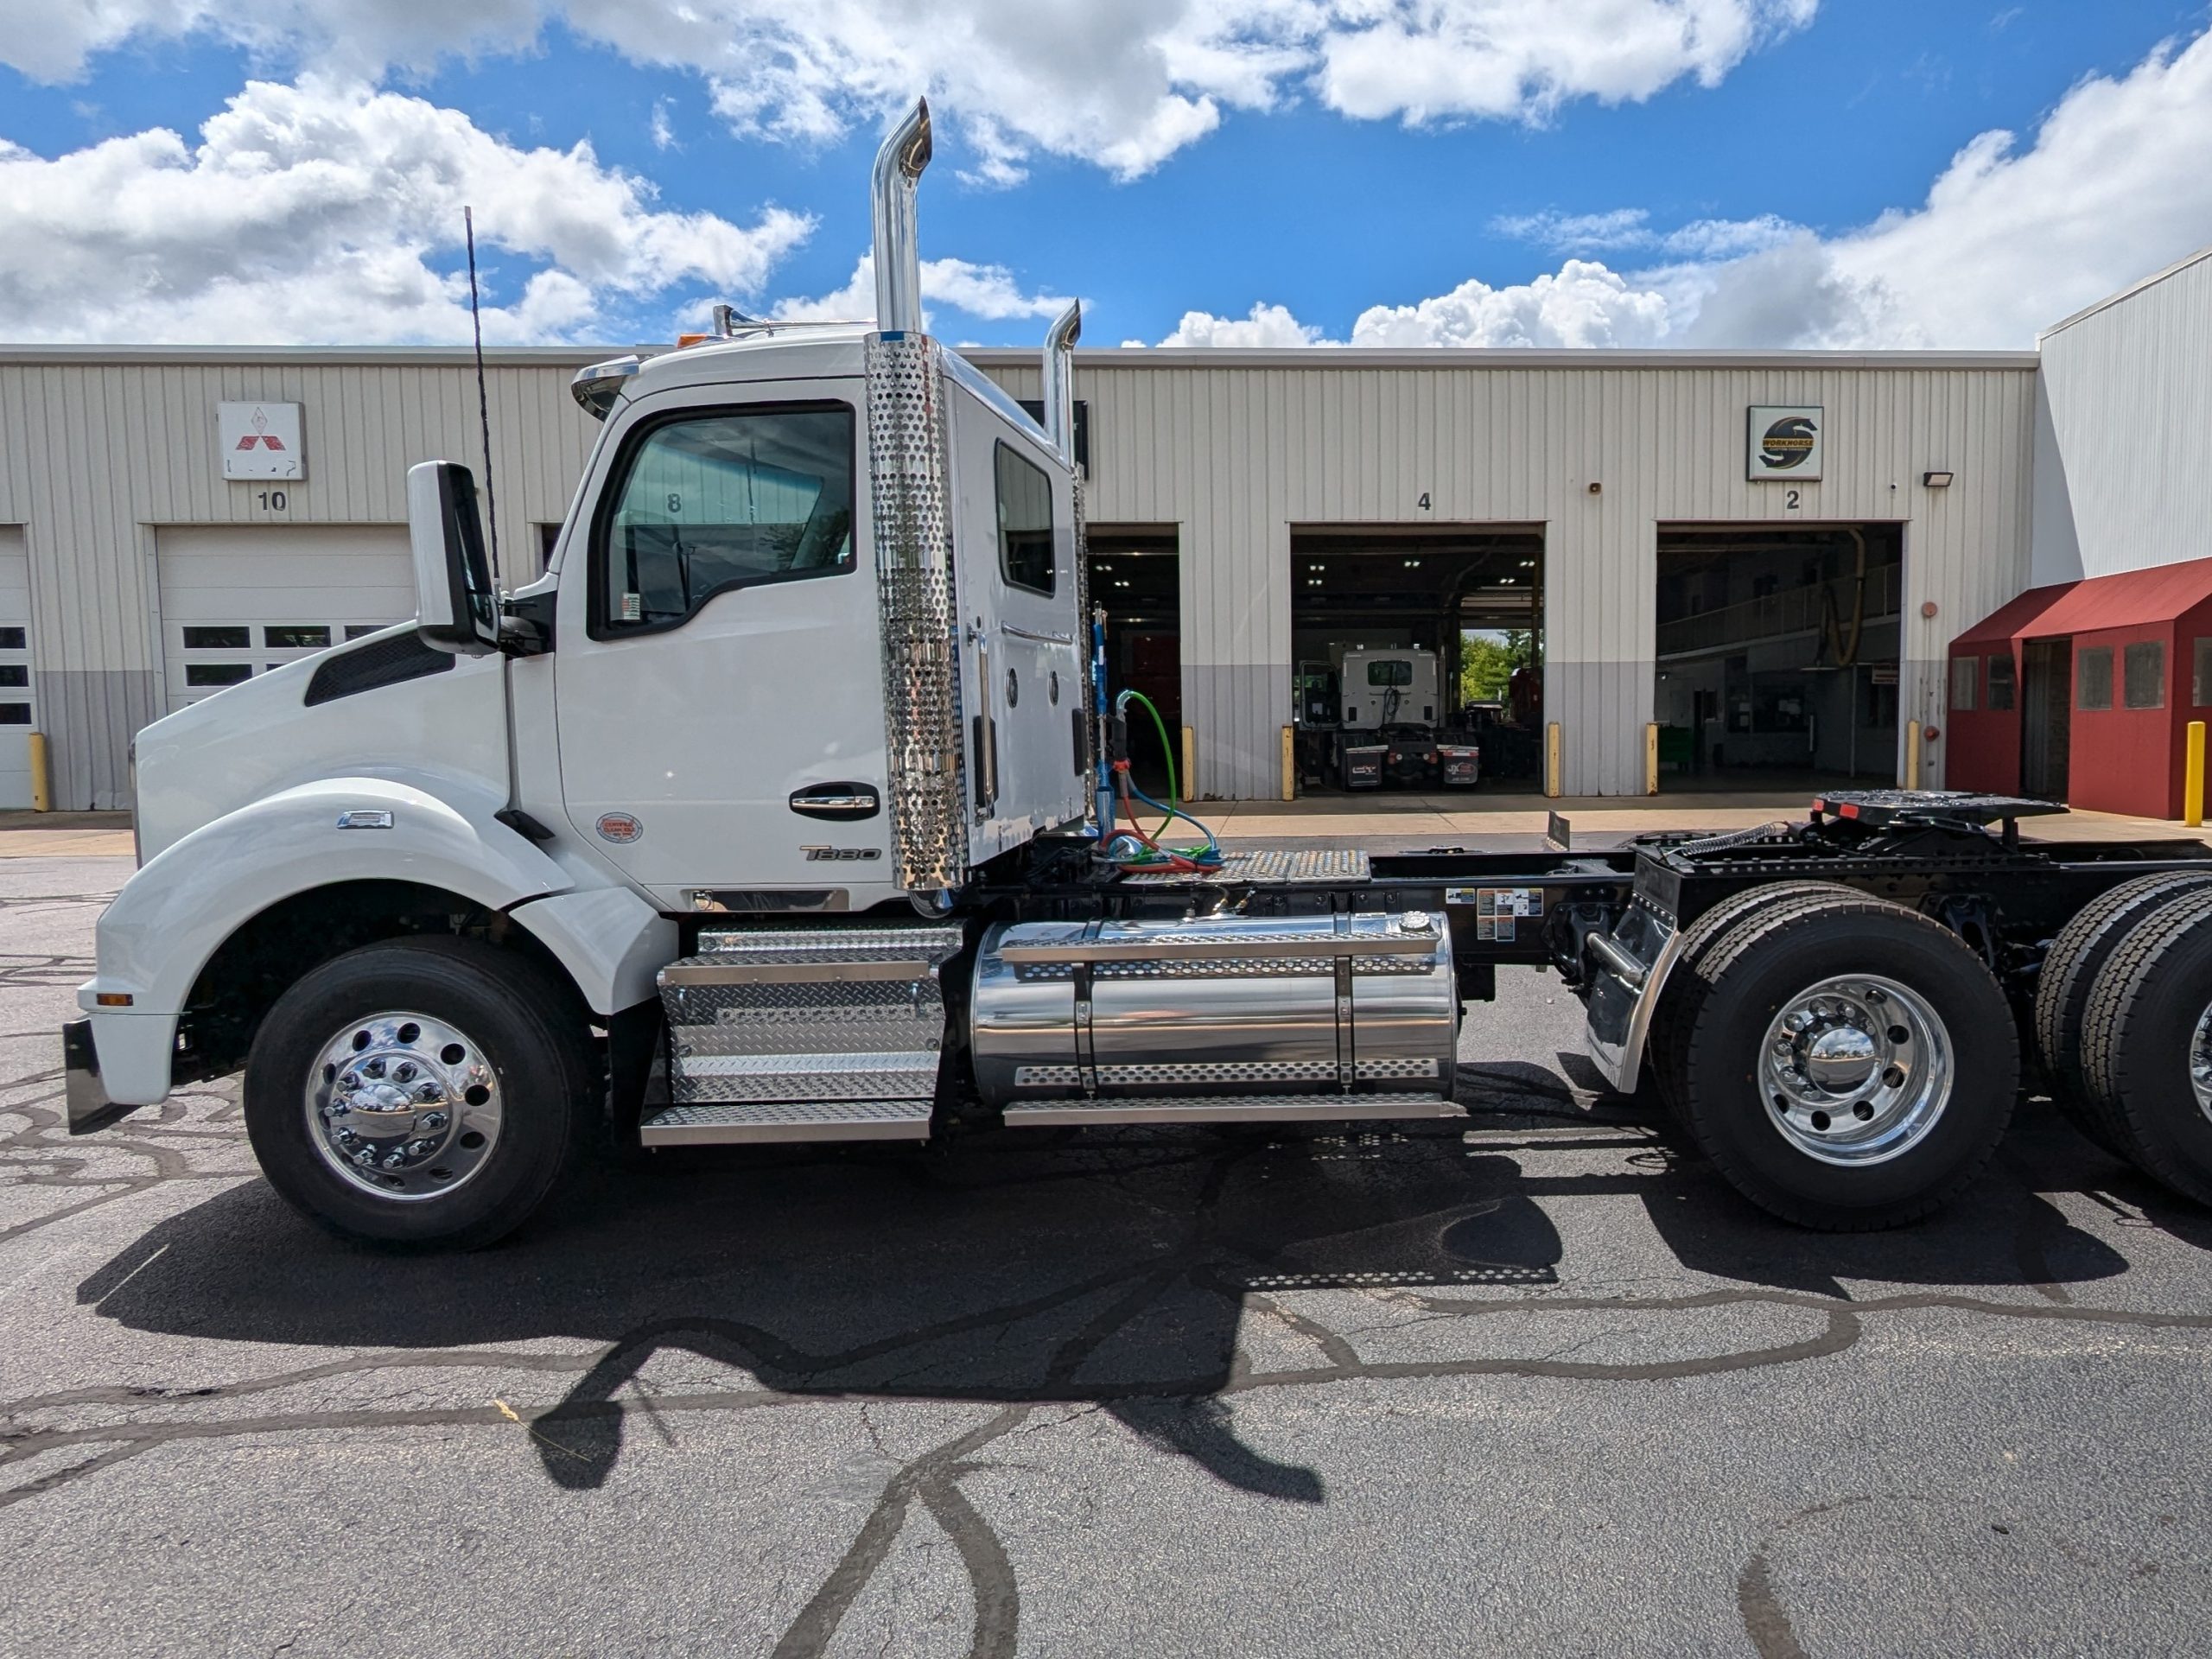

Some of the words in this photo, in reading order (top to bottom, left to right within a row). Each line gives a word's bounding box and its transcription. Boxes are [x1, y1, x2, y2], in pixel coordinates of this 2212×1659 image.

[258, 491, 287, 512] 10
[667, 493, 682, 513] 8
[1417, 492, 1432, 511] 4
[1786, 490, 1799, 509] 2
[799, 846, 882, 861] T880
